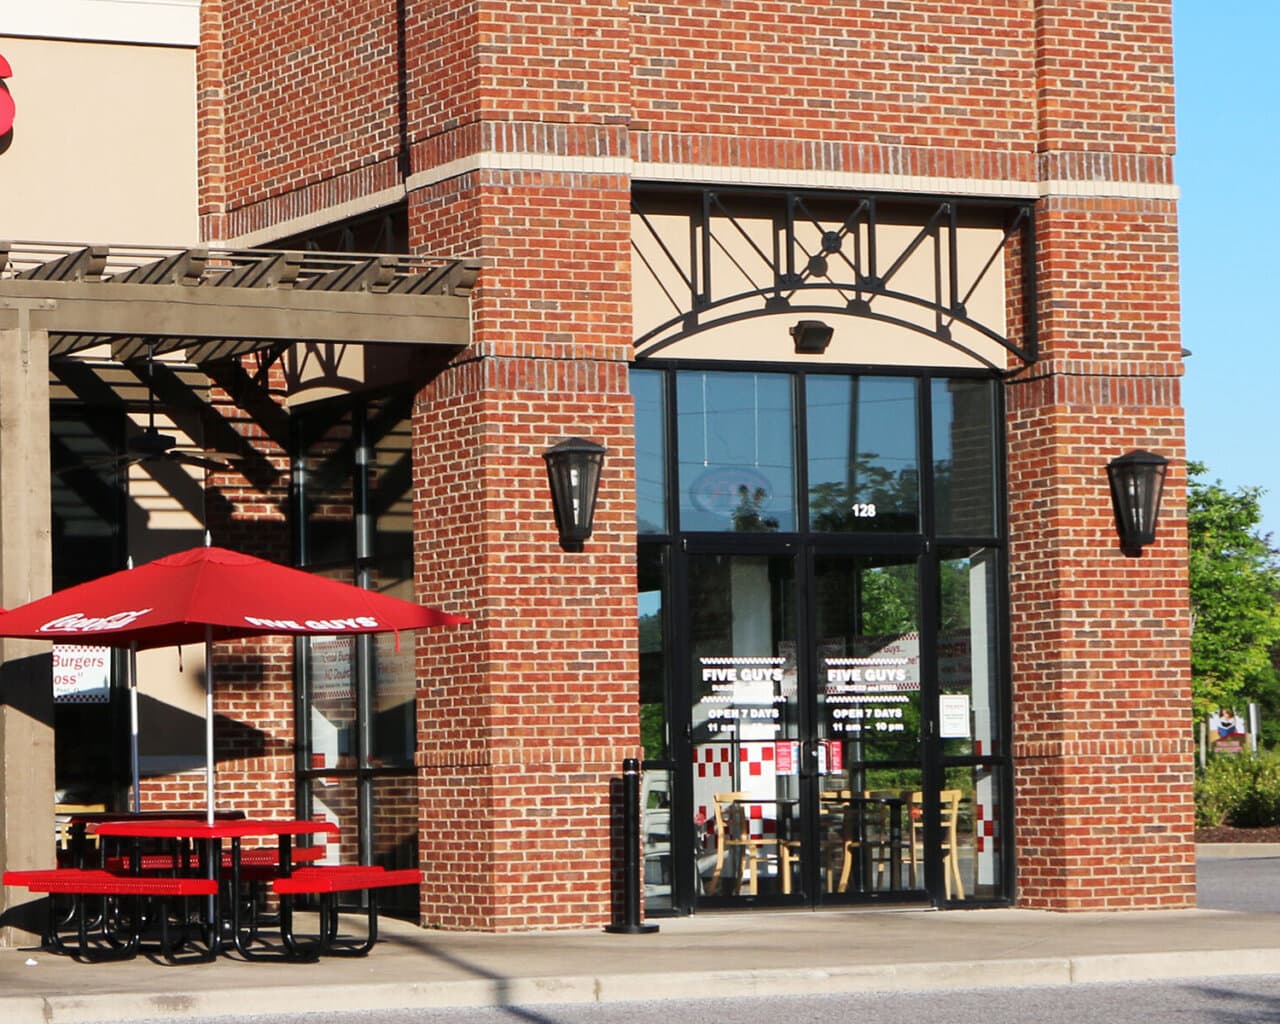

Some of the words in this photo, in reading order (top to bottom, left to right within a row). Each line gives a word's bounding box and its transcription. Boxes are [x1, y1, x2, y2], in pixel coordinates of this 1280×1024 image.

[852, 503, 877, 517] 128
[702, 668, 737, 682] FIVE
[740, 668, 783, 682] GUYS
[827, 668, 861, 682] FIVE
[864, 668, 906, 682] GUYS
[708, 708, 739, 719] OPEN
[740, 708, 748, 719] 7
[750, 708, 780, 719] DAYS
[833, 708, 863, 719] OPEN
[865, 708, 873, 719] 7
[874, 708, 903, 719] DAYS
[832, 722, 843, 732] 11
